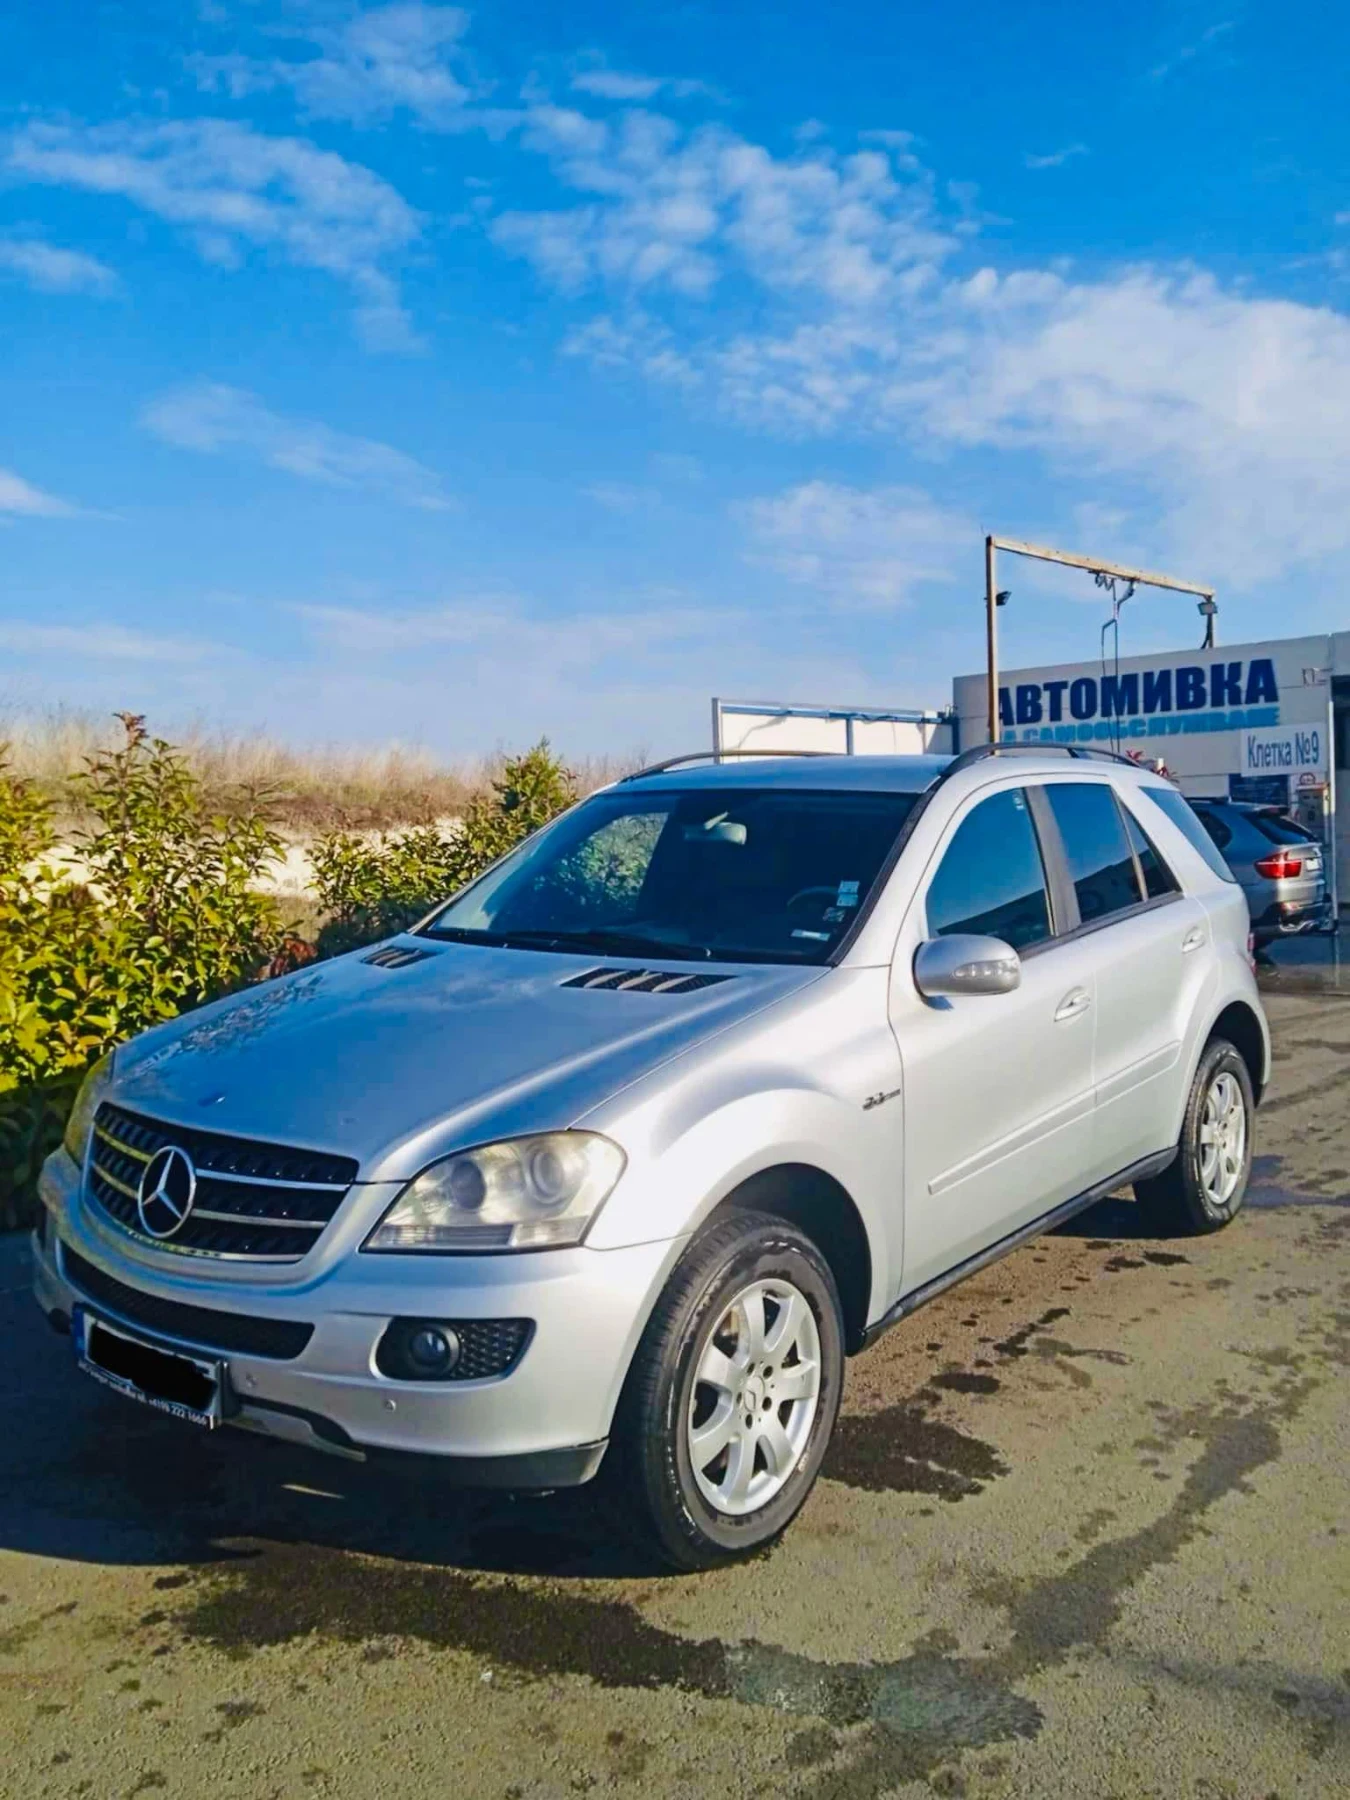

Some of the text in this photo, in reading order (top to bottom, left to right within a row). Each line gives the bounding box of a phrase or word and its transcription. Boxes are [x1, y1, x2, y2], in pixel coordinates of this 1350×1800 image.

[998, 658, 1279, 726] АВТОМИВКА
[1247, 730, 1320, 768] Клетка №9
